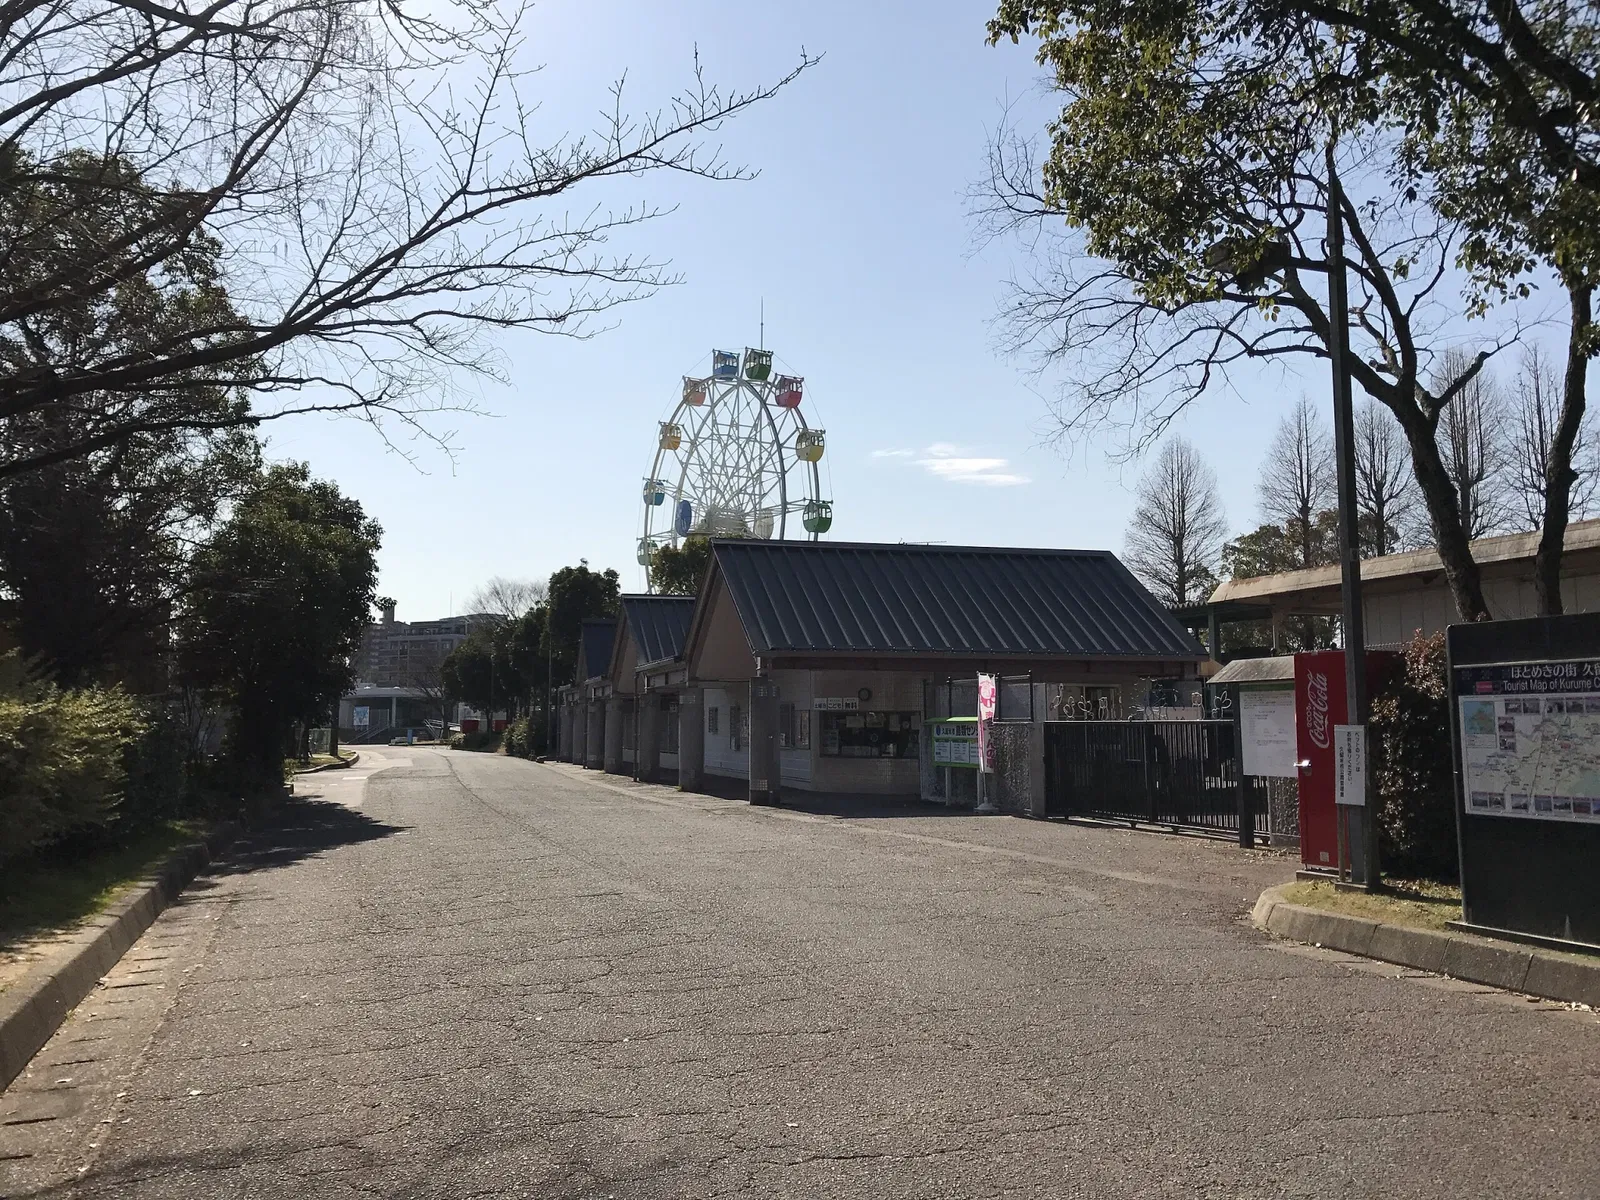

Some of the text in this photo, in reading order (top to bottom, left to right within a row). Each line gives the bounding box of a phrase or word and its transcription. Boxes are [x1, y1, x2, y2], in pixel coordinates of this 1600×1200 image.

[1511, 664, 1577, 678] ほとめきの街
[1503, 680, 1528, 691] Tourist
[1530, 679, 1548, 692] Map
[1549, 679, 1558, 690] of
[1559, 678, 1592, 689] Kurume
[1306, 669, 1330, 749] Coca-Cola
